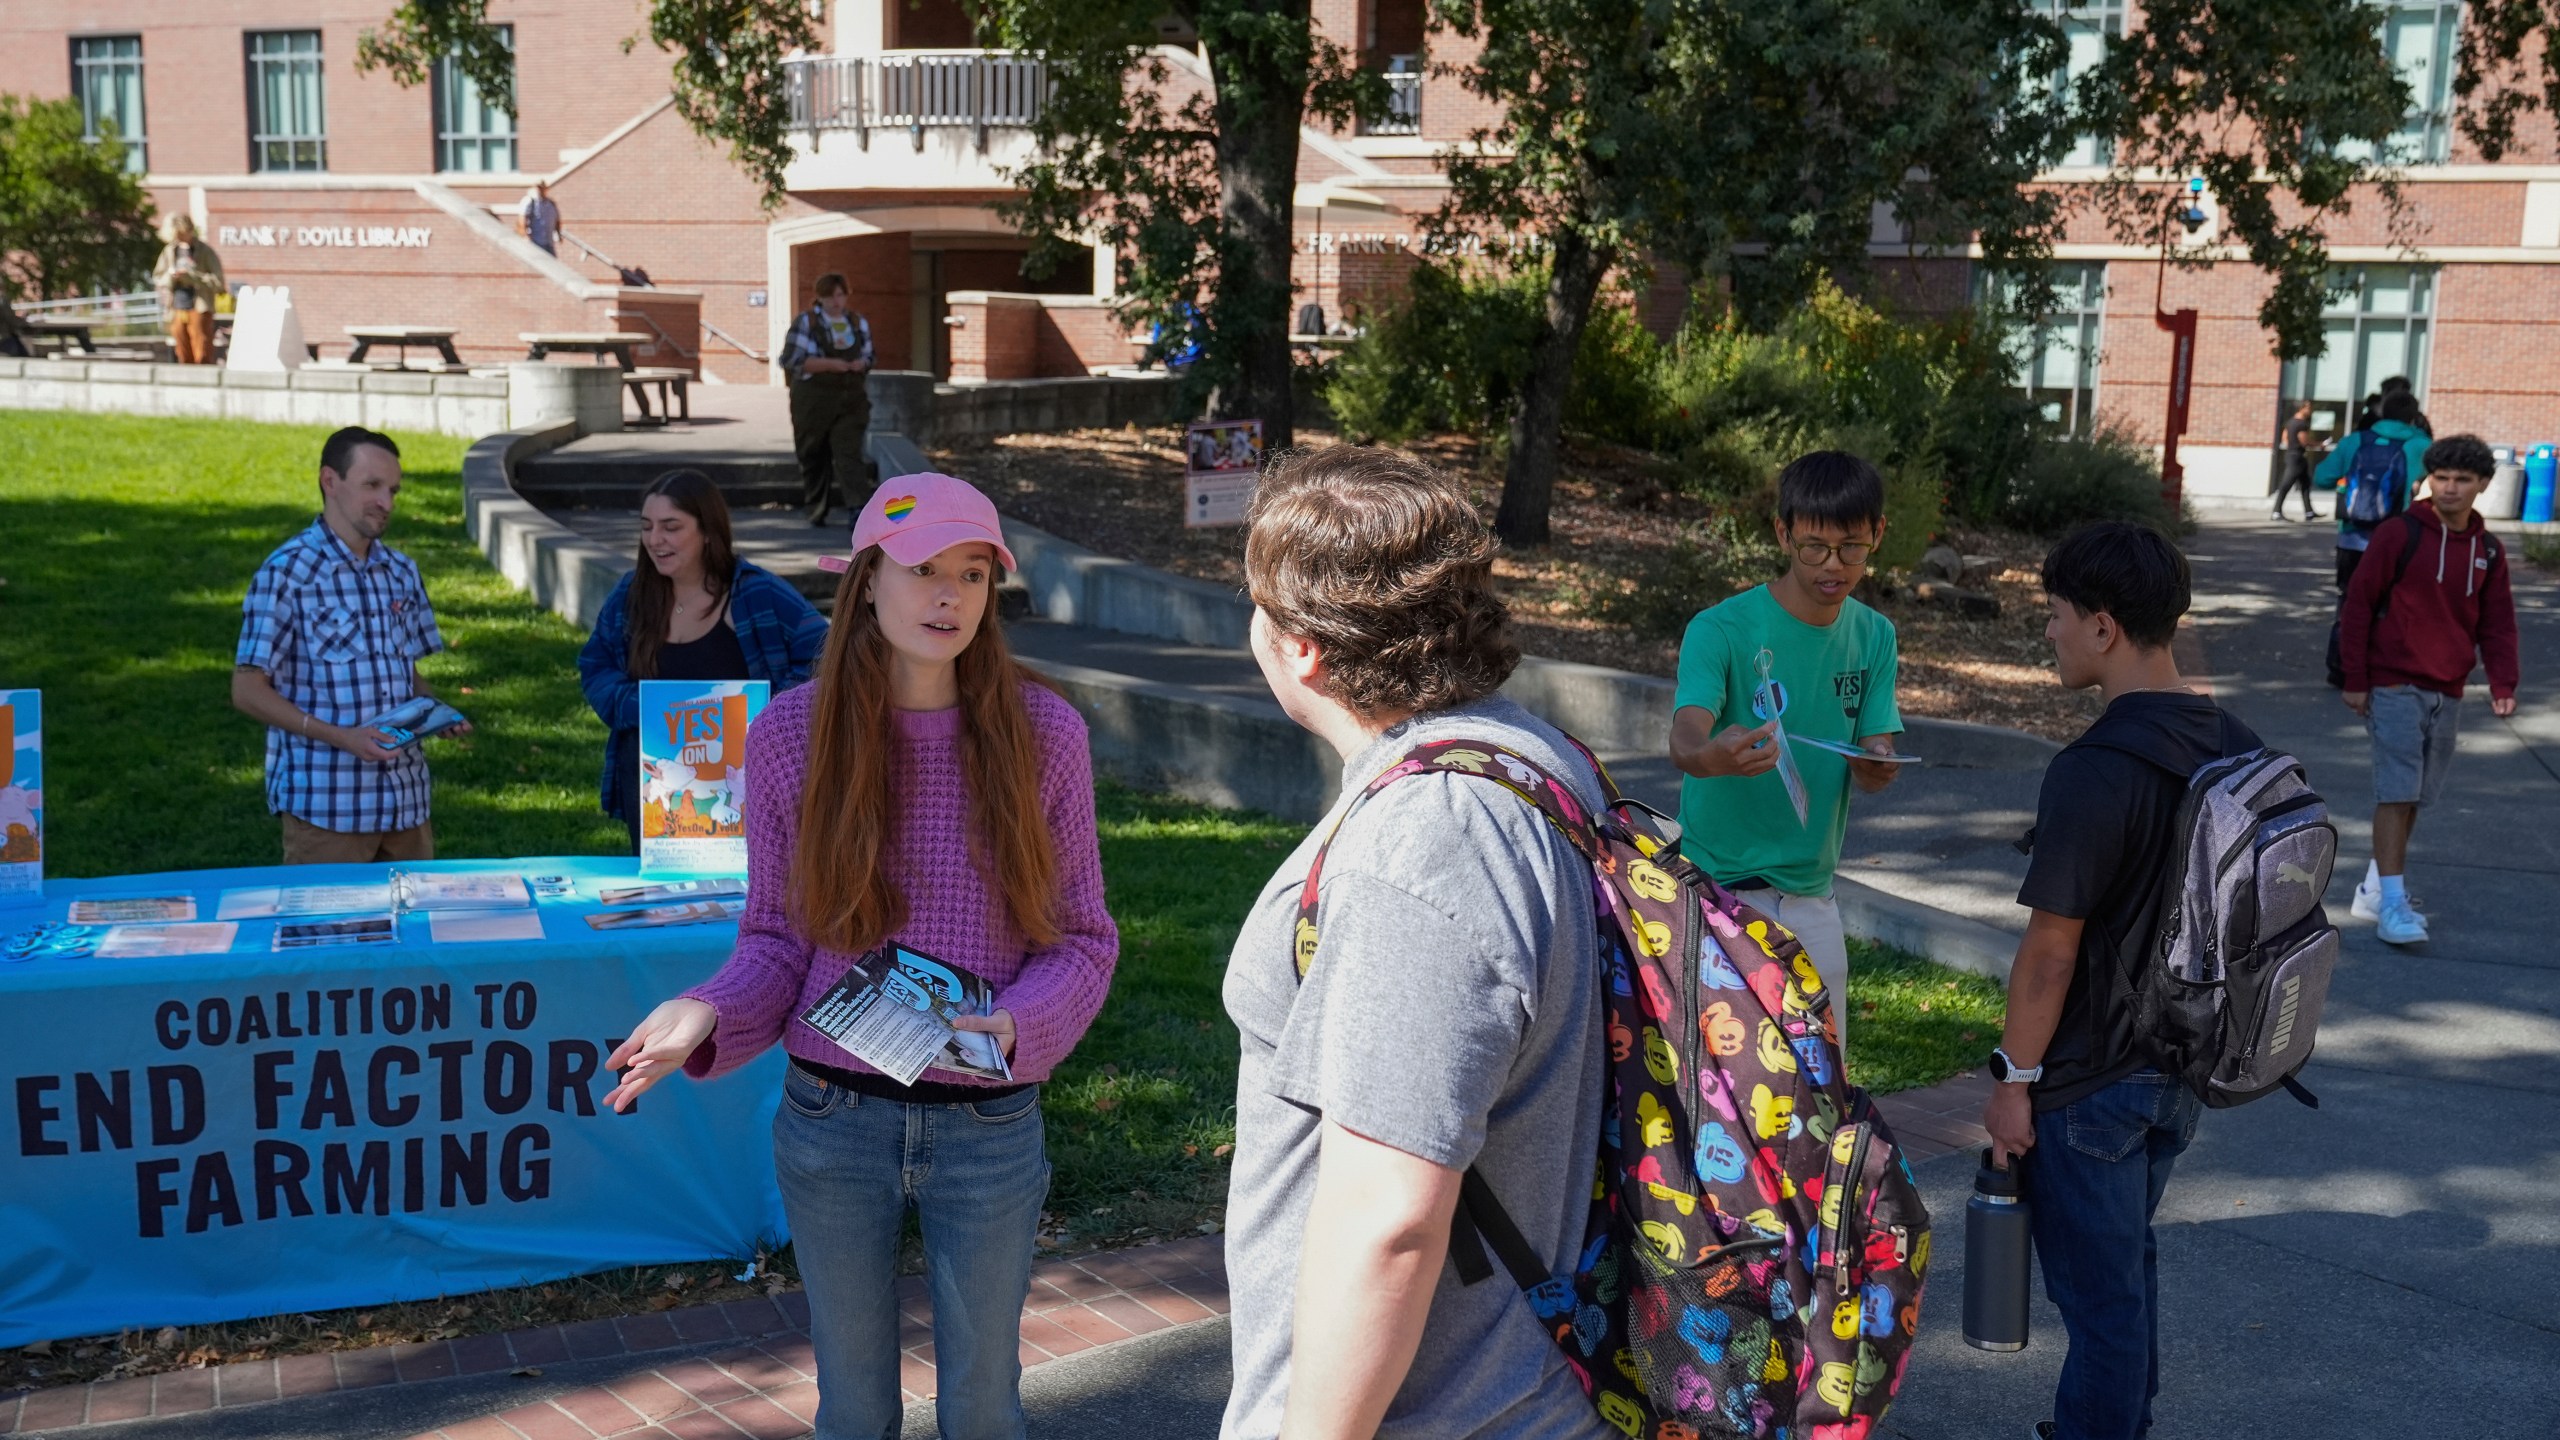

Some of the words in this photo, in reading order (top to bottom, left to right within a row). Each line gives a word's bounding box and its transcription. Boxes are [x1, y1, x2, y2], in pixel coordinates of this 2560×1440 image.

[220, 226, 276, 246] FRANK
[297, 227, 355, 247] DOYLE
[358, 227, 432, 247] LIBRARY
[1308, 233, 1386, 254] FRANK
[1833, 675, 1860, 697] YES
[1842, 698, 1854, 709] ON
[664, 707, 721, 745] YES
[685, 747, 706, 766] ON
[883, 980, 909, 1004] YES
[155, 983, 451, 1050] COALITION
[474, 981, 538, 1031] TO
[2270, 975, 2300, 1056] PUMA
[16, 1065, 206, 1157] END
[136, 1124, 551, 1238] FARMING
